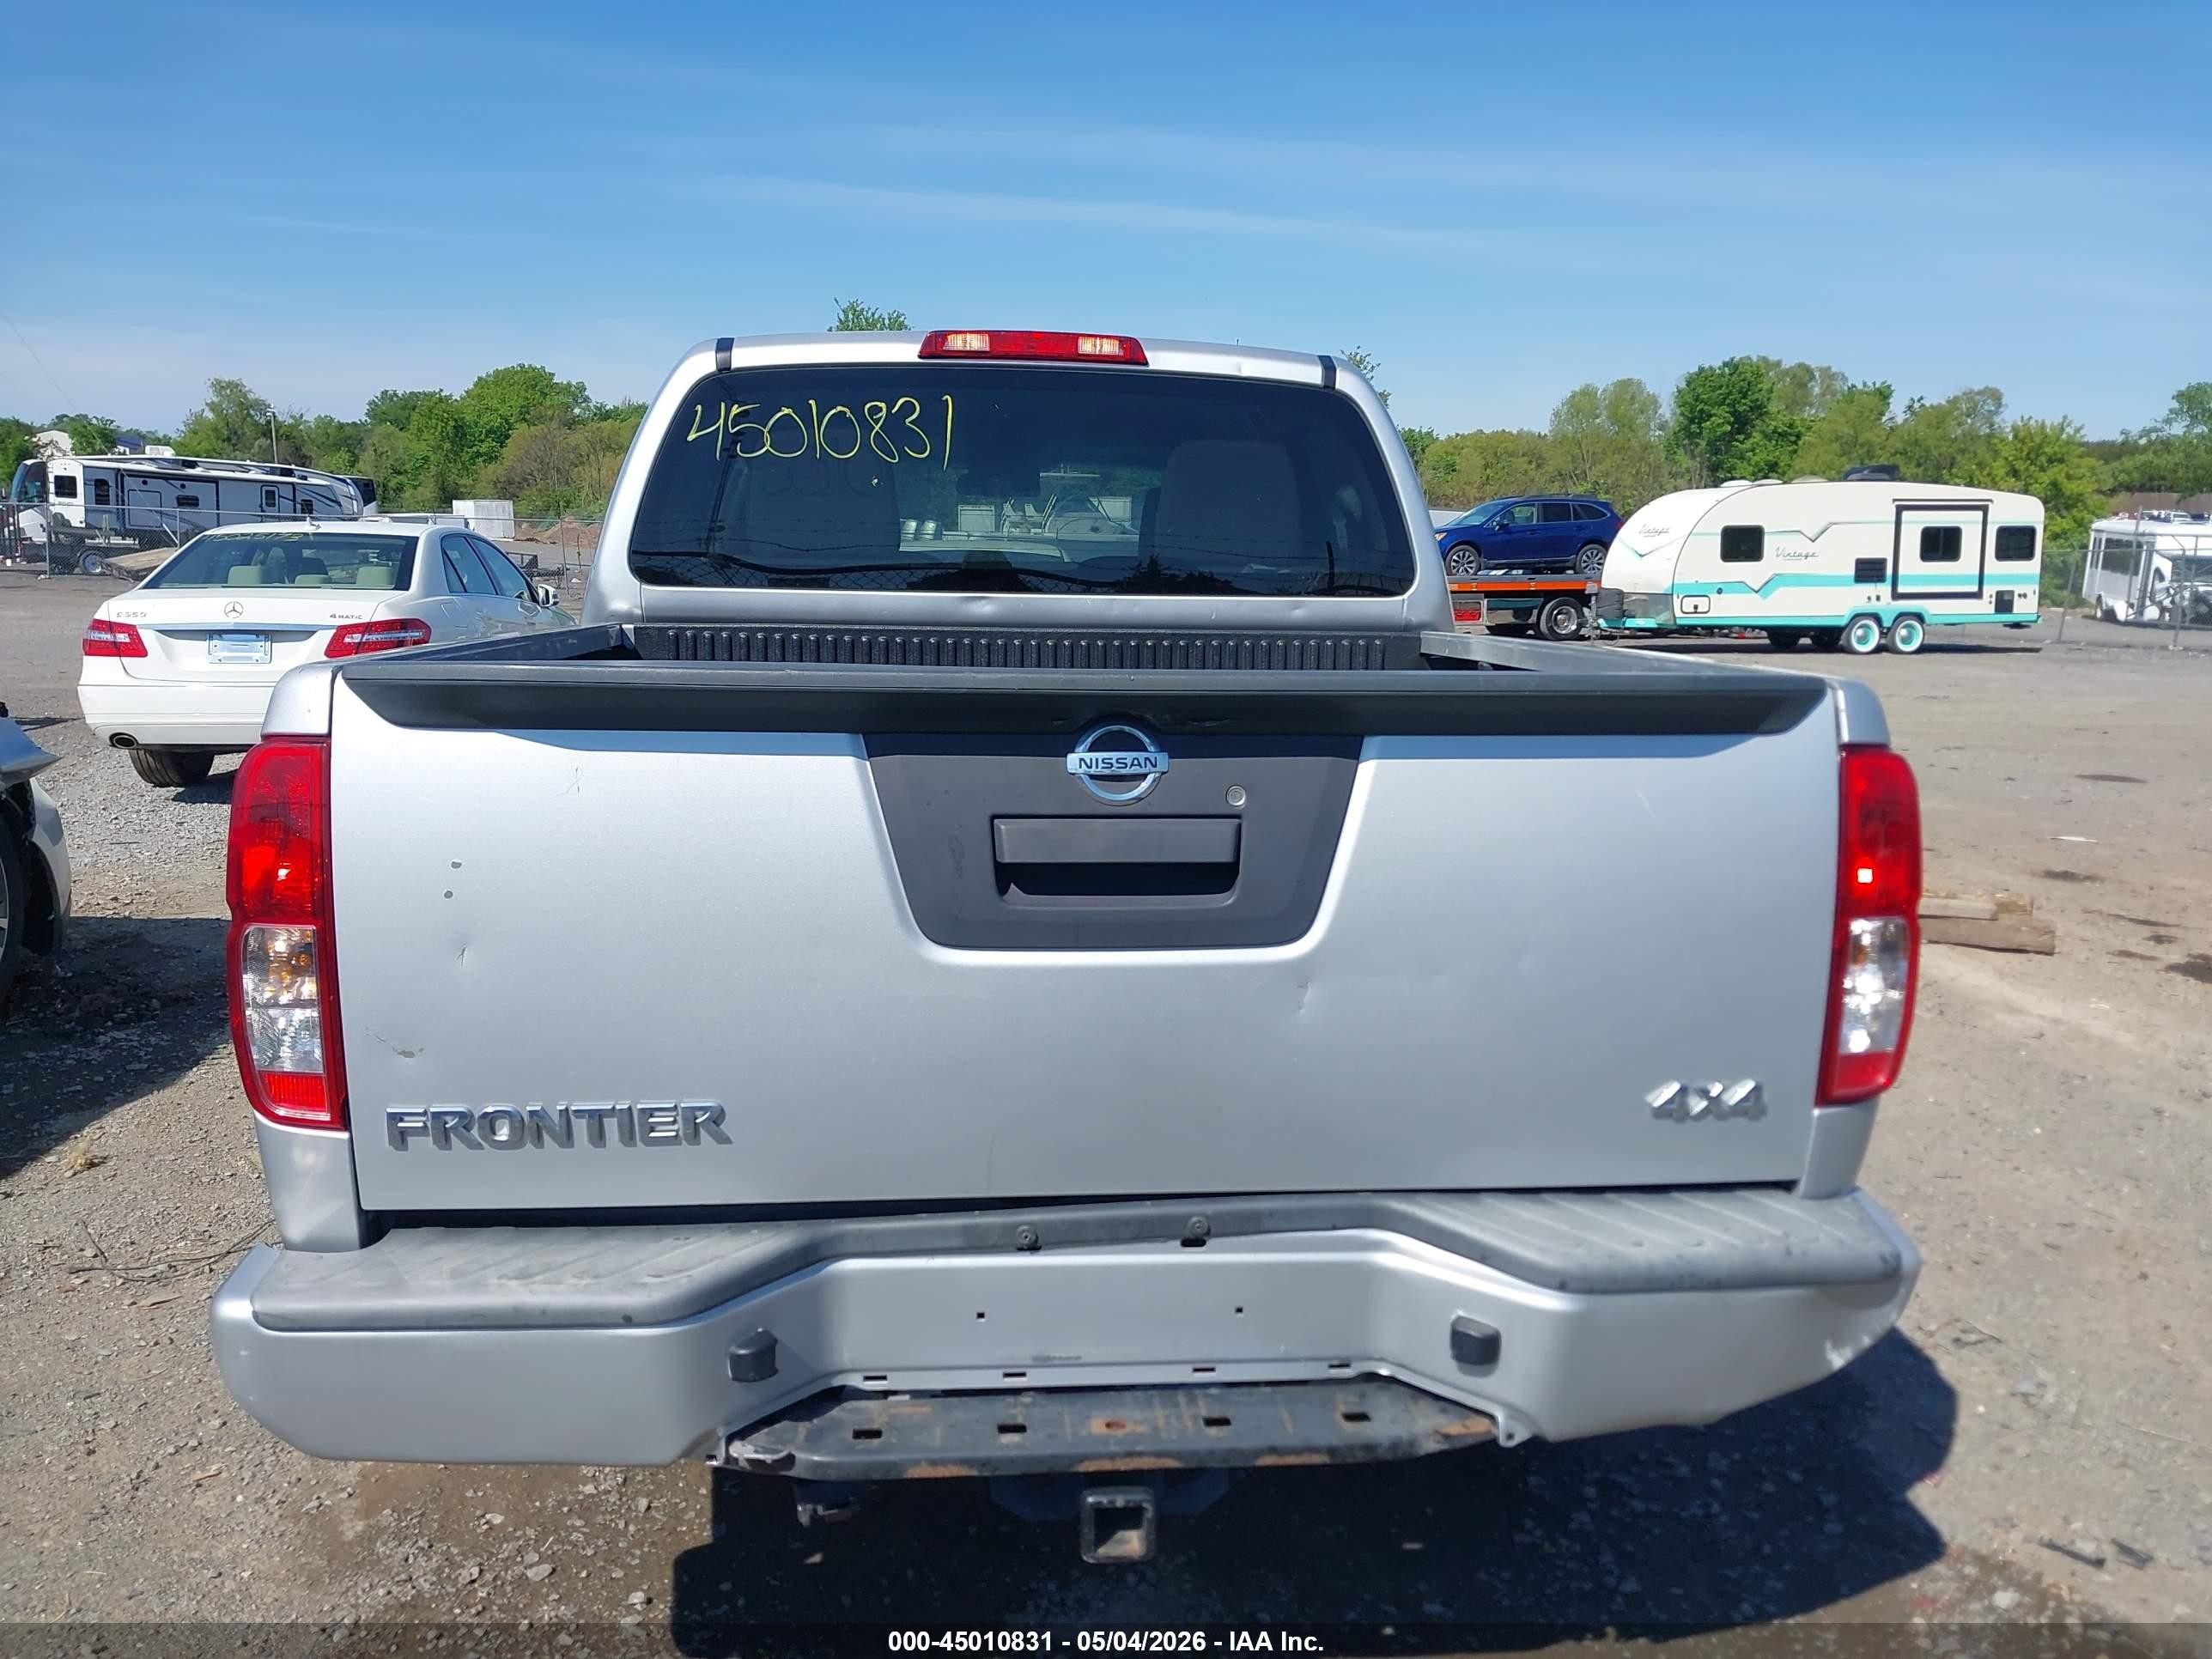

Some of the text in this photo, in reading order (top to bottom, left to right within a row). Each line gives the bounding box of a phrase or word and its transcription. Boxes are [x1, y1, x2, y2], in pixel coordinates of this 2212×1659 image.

[687, 395, 953, 471] 45010831
[1079, 757, 1158, 769] NISSAN
[386, 1100, 733, 1152] FRONTIER
